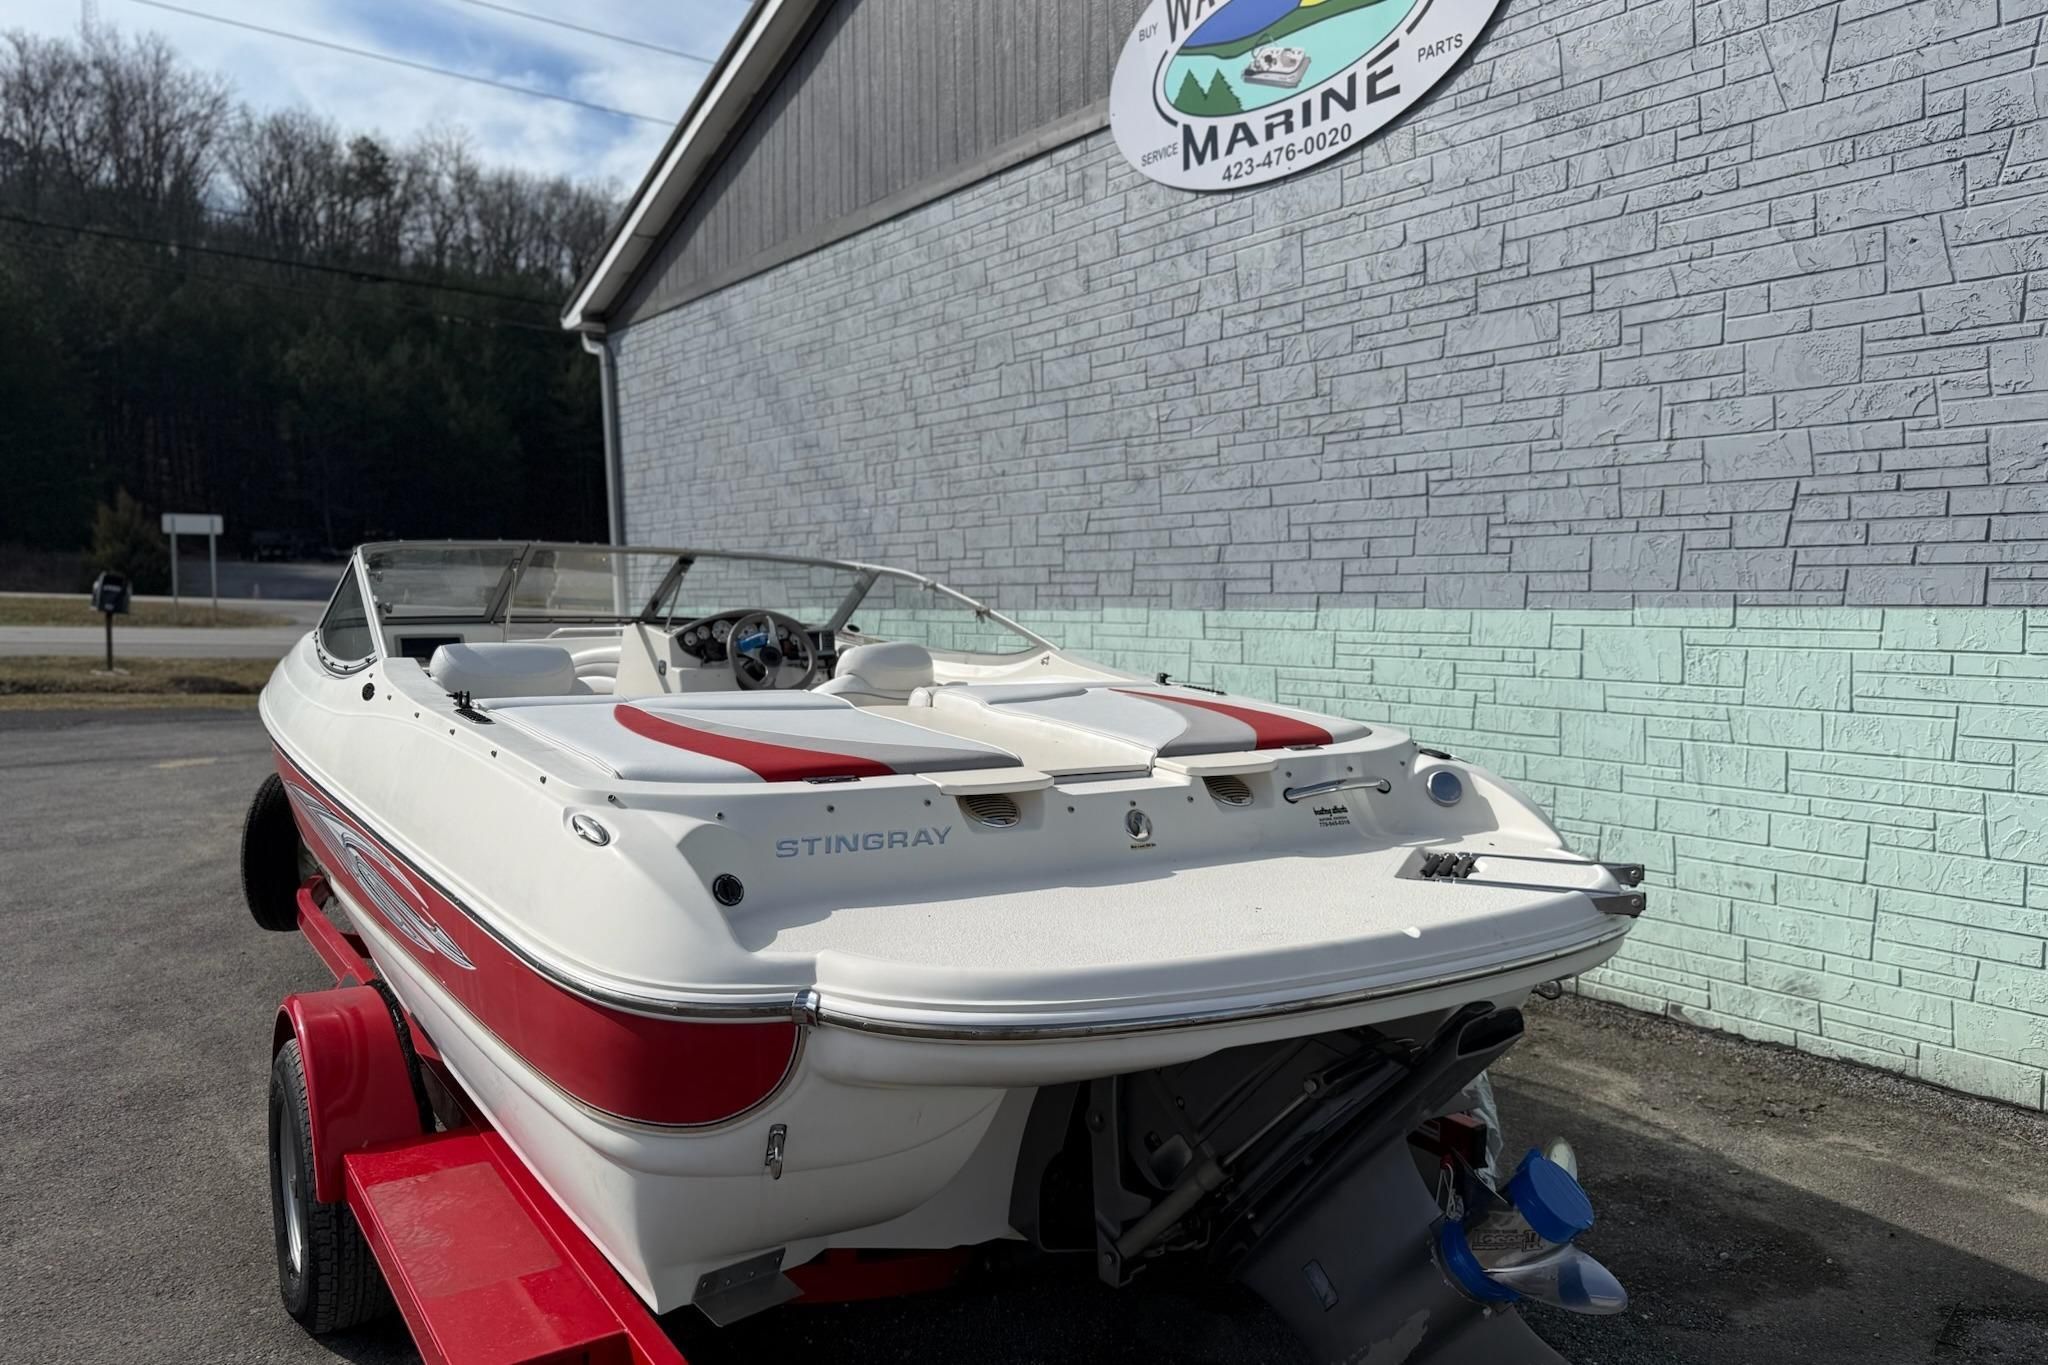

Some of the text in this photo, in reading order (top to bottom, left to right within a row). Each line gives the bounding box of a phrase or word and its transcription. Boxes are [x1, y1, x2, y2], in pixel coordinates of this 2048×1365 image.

[1138, 22, 1158, 42] BUY
[1417, 33, 1464, 63] PARTS
[1182, 38, 1401, 171] MARINE
[1141, 142, 1179, 168] SERVICE
[1222, 123, 1352, 183] 423-476-0020
[775, 825, 953, 858] STINGRAY
